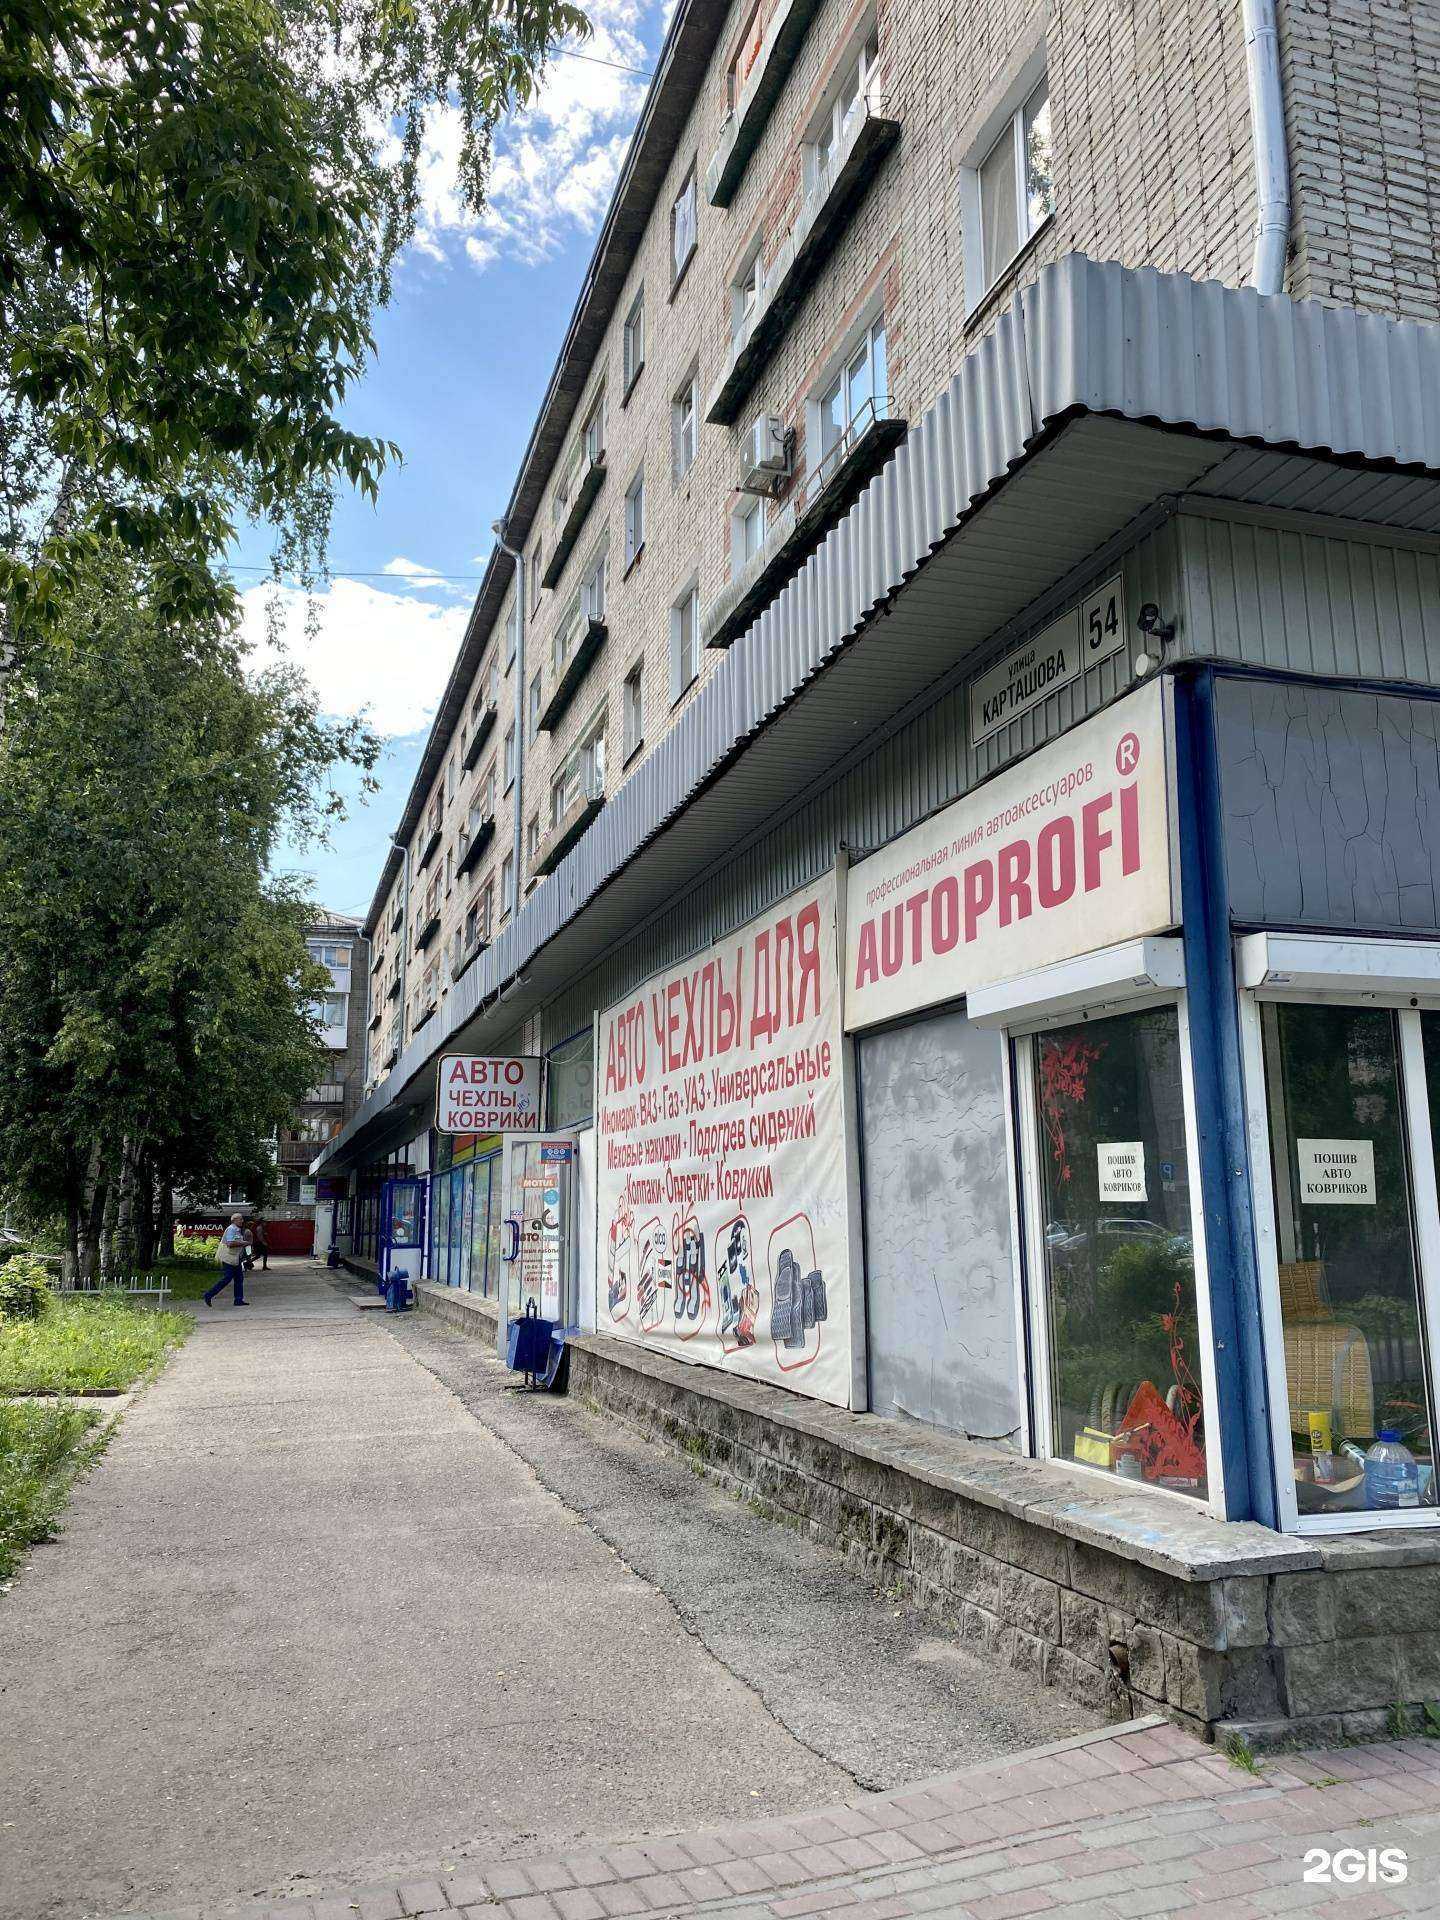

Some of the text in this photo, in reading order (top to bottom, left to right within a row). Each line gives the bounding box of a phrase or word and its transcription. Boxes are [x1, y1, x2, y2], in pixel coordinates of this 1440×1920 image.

[1089, 595, 1118, 649] 54
[1007, 649, 1036, 680] улица
[983, 649, 1066, 726] КАРТАШОВА
[866, 762, 1093, 906] профессиональная линия автоаксессуаров
[605, 1000, 646, 1096] АВТО
[652, 946, 743, 1074] ЧЕХЛЫ
[750, 899, 821, 1050] ДЛЯ
[449, 1060, 524, 1085] АВТО
[449, 1090, 517, 1107] ЧЕХЛЫ
[602, 1041, 831, 1138] Иномарок ВАЗ Газ УАЗ Универсальные
[448, 1111, 536, 1129] КОВРИКИ
[607, 1089, 816, 1169] Меховые накидки Подогрев сидений
[1107, 1155, 1136, 1164] ПОШИВ
[1313, 1153, 1358, 1164] ПОШИВ
[1112, 1169, 1132, 1178] АВТО
[1322, 1168, 1352, 1179] АВТО
[523, 1179, 554, 1188] MOTUL
[626, 1173, 662, 1205] Колпаки
[716, 1160, 774, 1210] Коврики
[1103, 1183, 1142, 1192] КОВРИКОВ
[1307, 1183, 1368, 1193] КОВРИКОВ
[194, 1223, 223, 1231] МАСЛА
